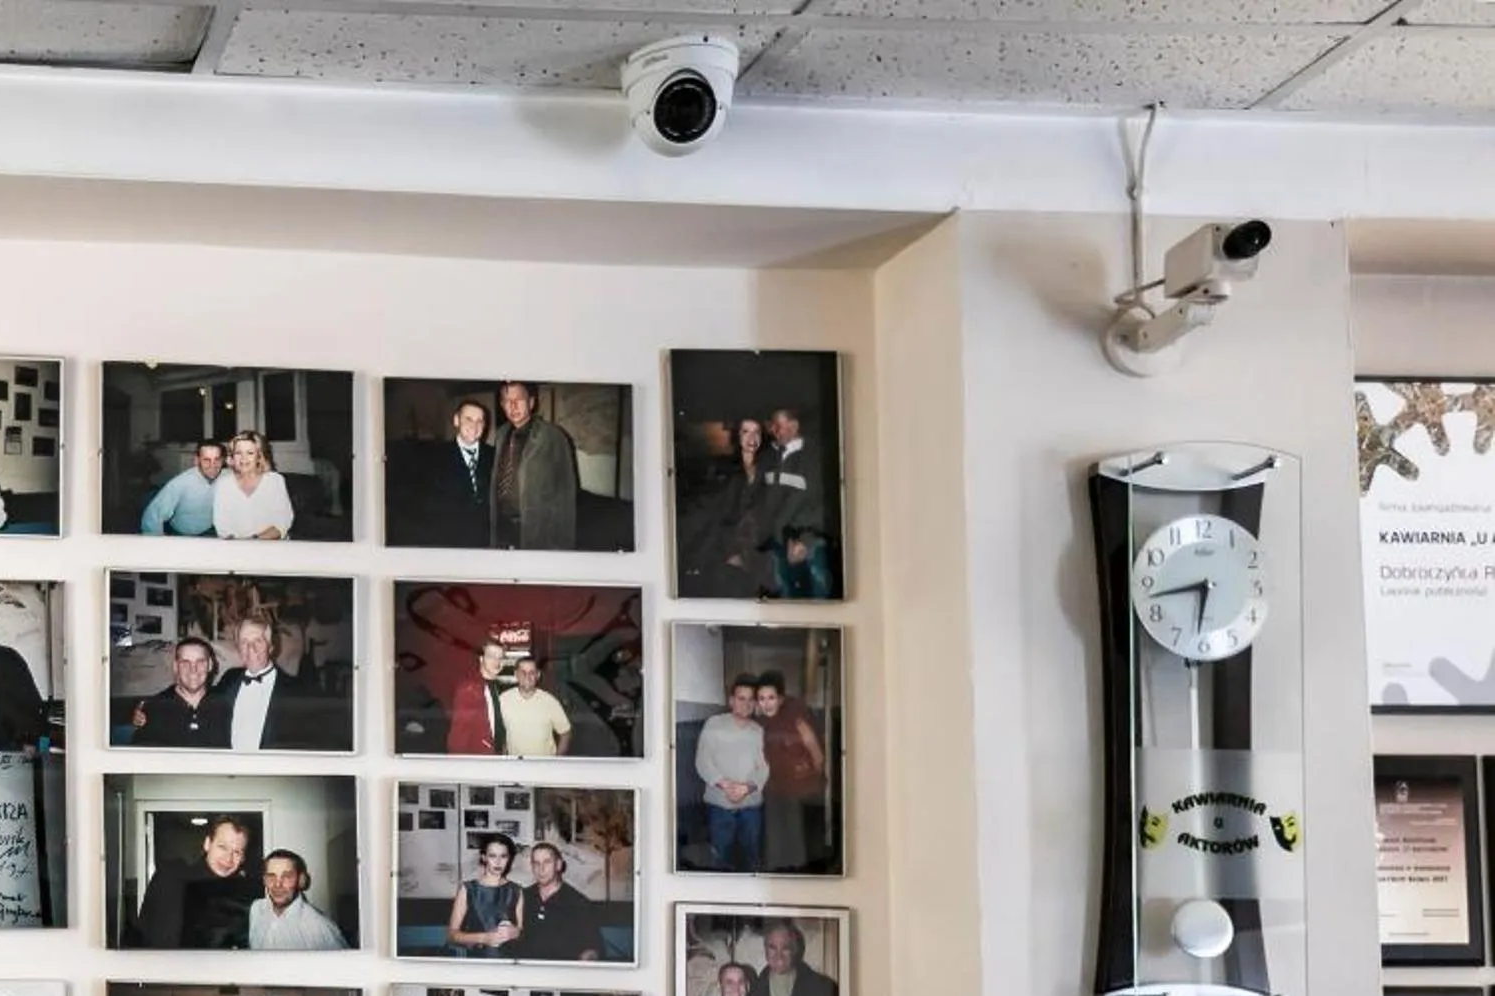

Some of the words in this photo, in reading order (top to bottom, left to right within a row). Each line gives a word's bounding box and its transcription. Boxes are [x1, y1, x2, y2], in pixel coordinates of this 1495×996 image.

[1169, 525, 1182, 545] 11
[1196, 519, 1212, 539] 12
[1229, 528, 1236, 549] 1
[1379, 531, 1466, 543] KAWIARNIA
[1147, 547, 1165, 567] 10
[1247, 550, 1259, 569] 2
[1141, 575, 1155, 592] 9
[1149, 603, 1163, 623] 8
[1171, 627, 1182, 647] 7
[1198, 633, 1211, 653] 6
[1226, 629, 1238, 646] 5
[1172, 792, 1267, 815] KAWIARNIA
